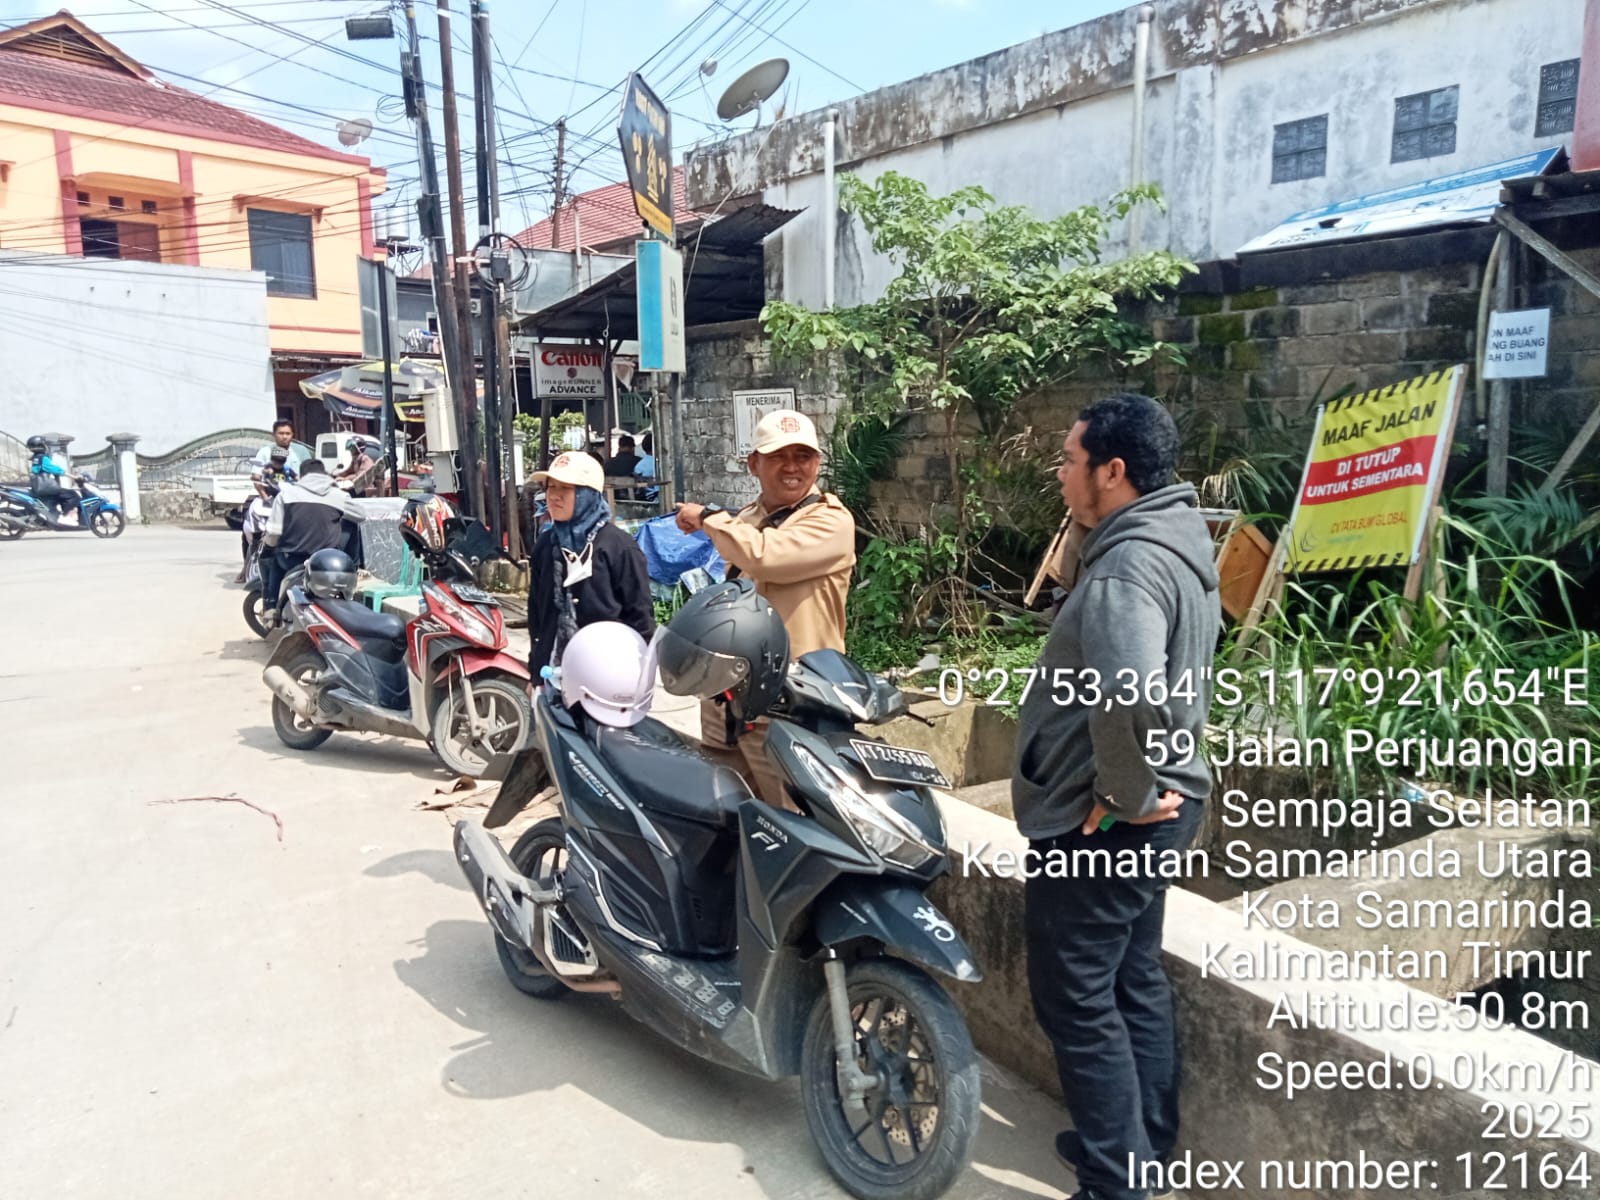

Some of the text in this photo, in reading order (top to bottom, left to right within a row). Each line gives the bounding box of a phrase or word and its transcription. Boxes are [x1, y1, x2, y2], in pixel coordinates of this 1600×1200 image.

[1506, 325, 1535, 336] MAAF
[1509, 337, 1545, 349] BUANG
[541, 350, 602, 367] Canon
[1504, 352, 1515, 361] DI
[1517, 351, 1537, 361] SINI
[549, 385, 597, 394] ADVANCE
[745, 396, 781, 406] MENERIMA
[1322, 400, 1437, 446] MAAF JALAN
[1336, 447, 1401, 476] DI TUTUP
[1307, 462, 1423, 497] UNTUK SEMENTARA
[856, 743, 879, 760] KT
[875, 746, 913, 765] 2455
[756, 815, 789, 844] HONDA
